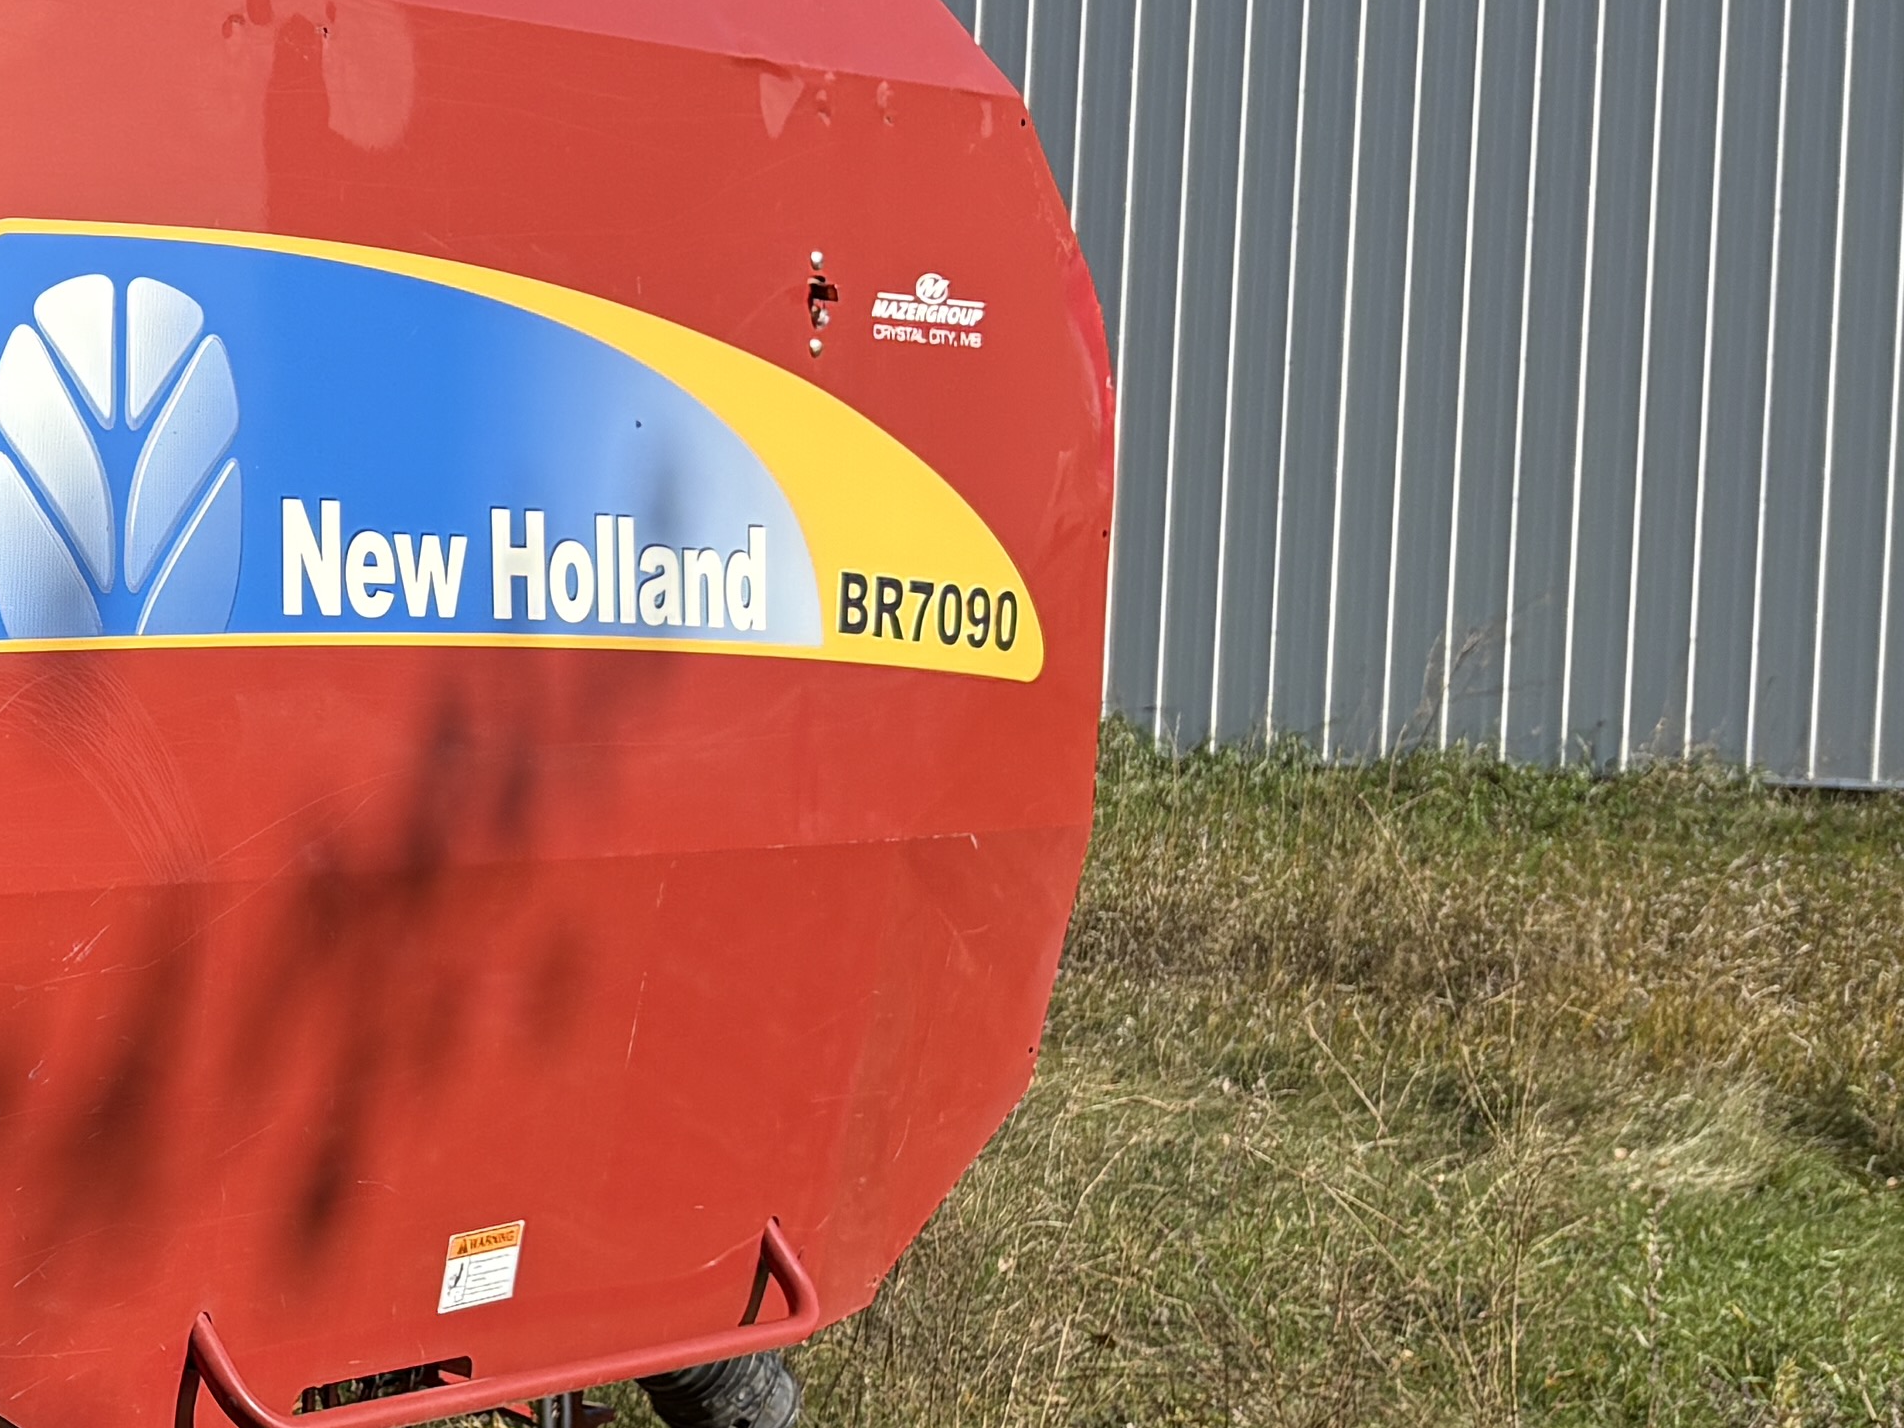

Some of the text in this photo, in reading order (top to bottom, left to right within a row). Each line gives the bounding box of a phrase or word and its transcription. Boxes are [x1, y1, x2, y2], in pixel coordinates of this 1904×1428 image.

[871, 299, 985, 326] MAZERGROUP
[873, 324, 928, 344] CRYSTAL
[960, 331, 982, 348] MB
[282, 496, 767, 631] New Holland
[839, 571, 1017, 651] BR7090
[470, 1230, 515, 1249] WARNING
